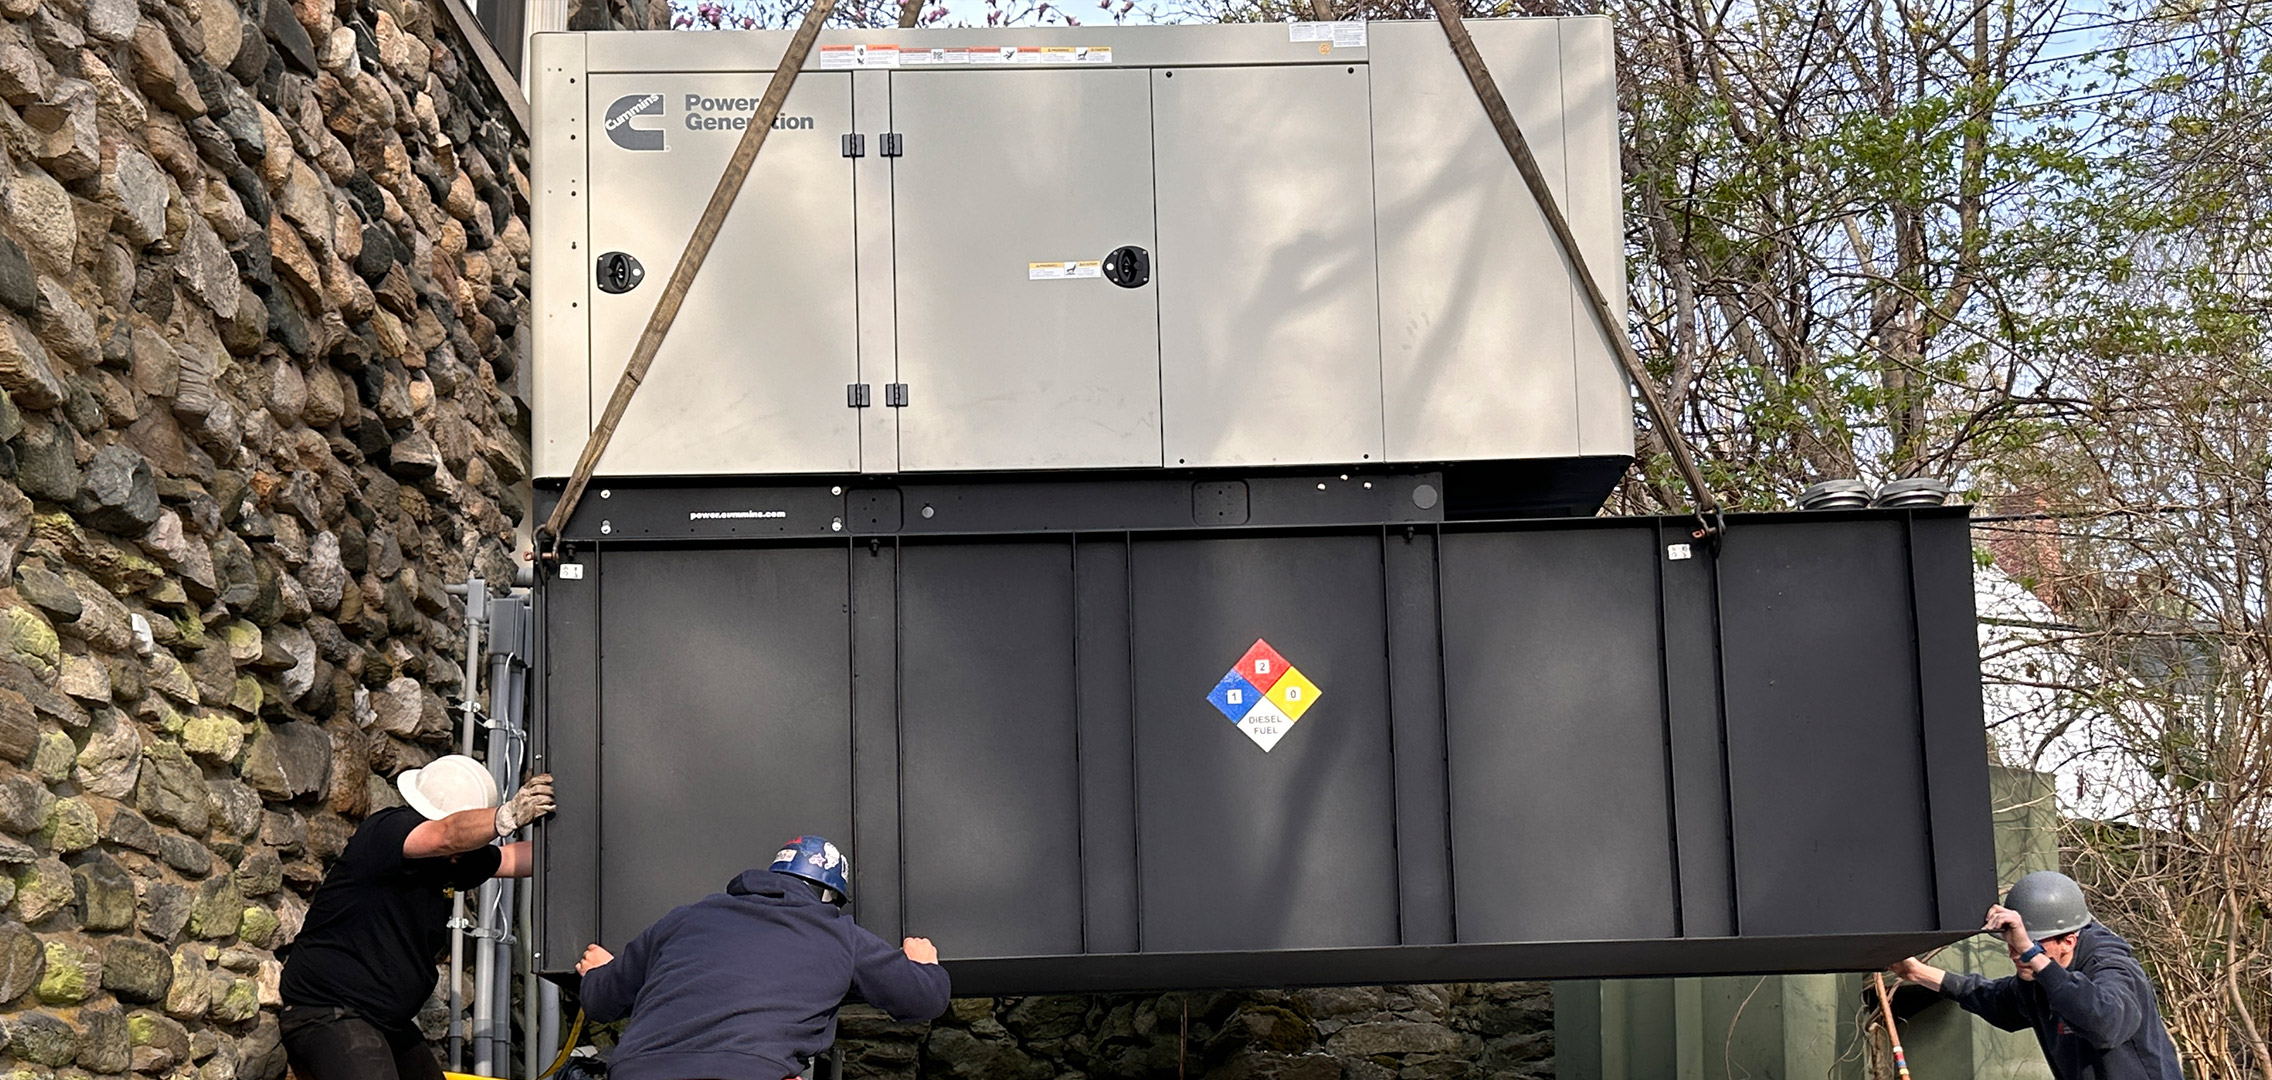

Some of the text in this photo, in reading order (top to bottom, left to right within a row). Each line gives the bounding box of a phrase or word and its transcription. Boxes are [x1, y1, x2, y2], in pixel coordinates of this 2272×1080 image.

[686, 94, 759, 111] Power
[605, 94, 660, 130] Cummins
[685, 112, 814, 130] Genetion
[1259, 662, 1266, 671] 2
[1231, 692, 1238, 701] 1
[1290, 689, 1297, 699] 0
[1248, 715, 1282, 724] DIESEL
[1253, 726, 1279, 735] FUEL
